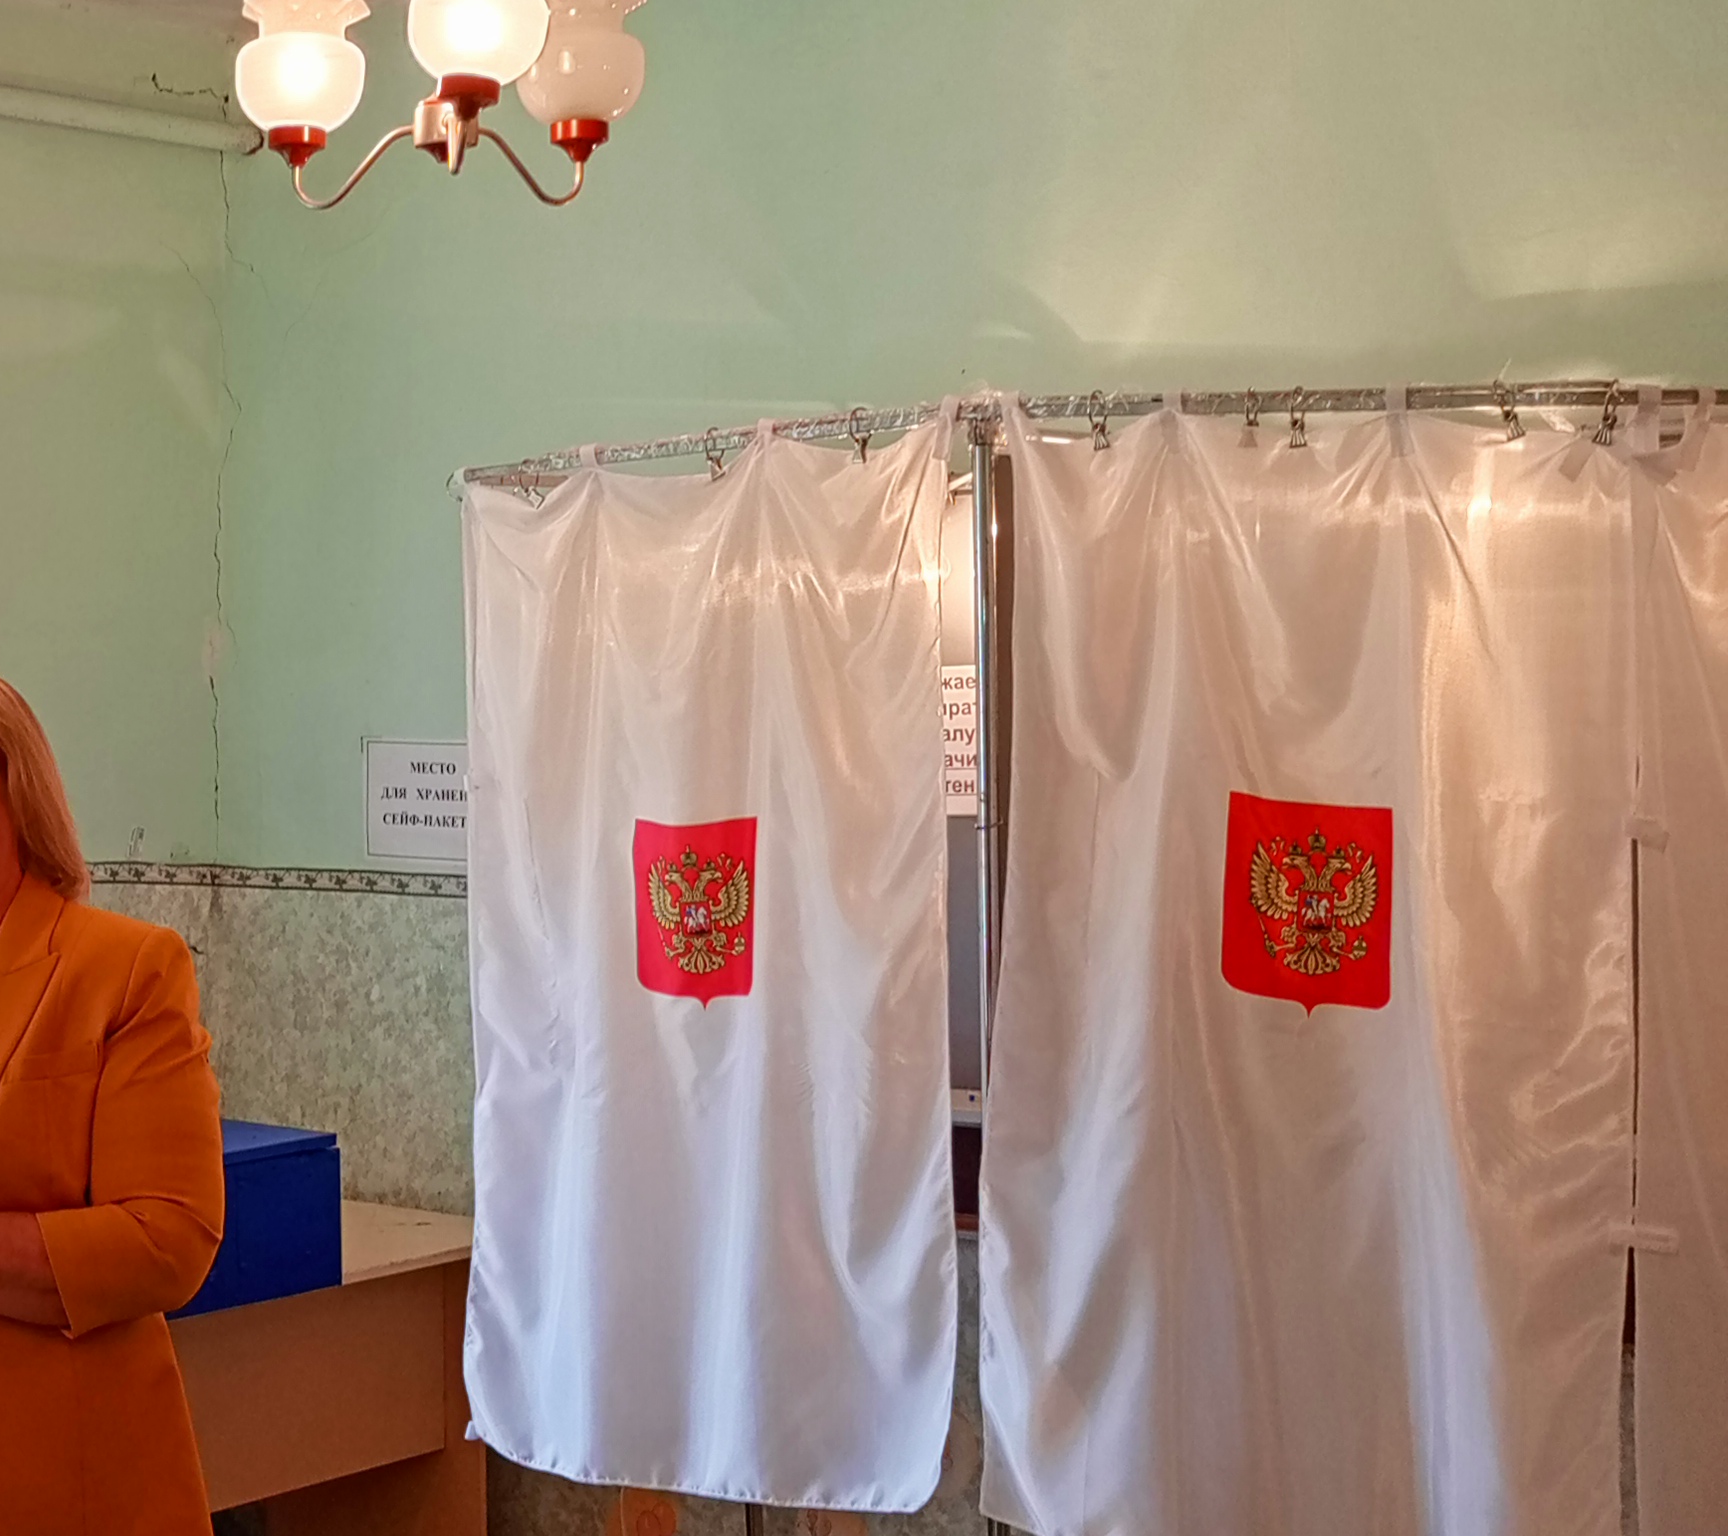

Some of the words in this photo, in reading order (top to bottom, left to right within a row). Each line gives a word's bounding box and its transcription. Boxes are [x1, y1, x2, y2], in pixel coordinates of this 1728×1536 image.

[410, 761, 456, 775] МЕСТО
[380, 786, 407, 801] ДЛЯ
[382, 810, 467, 829] СЕЙФ-ПАКЕТ
